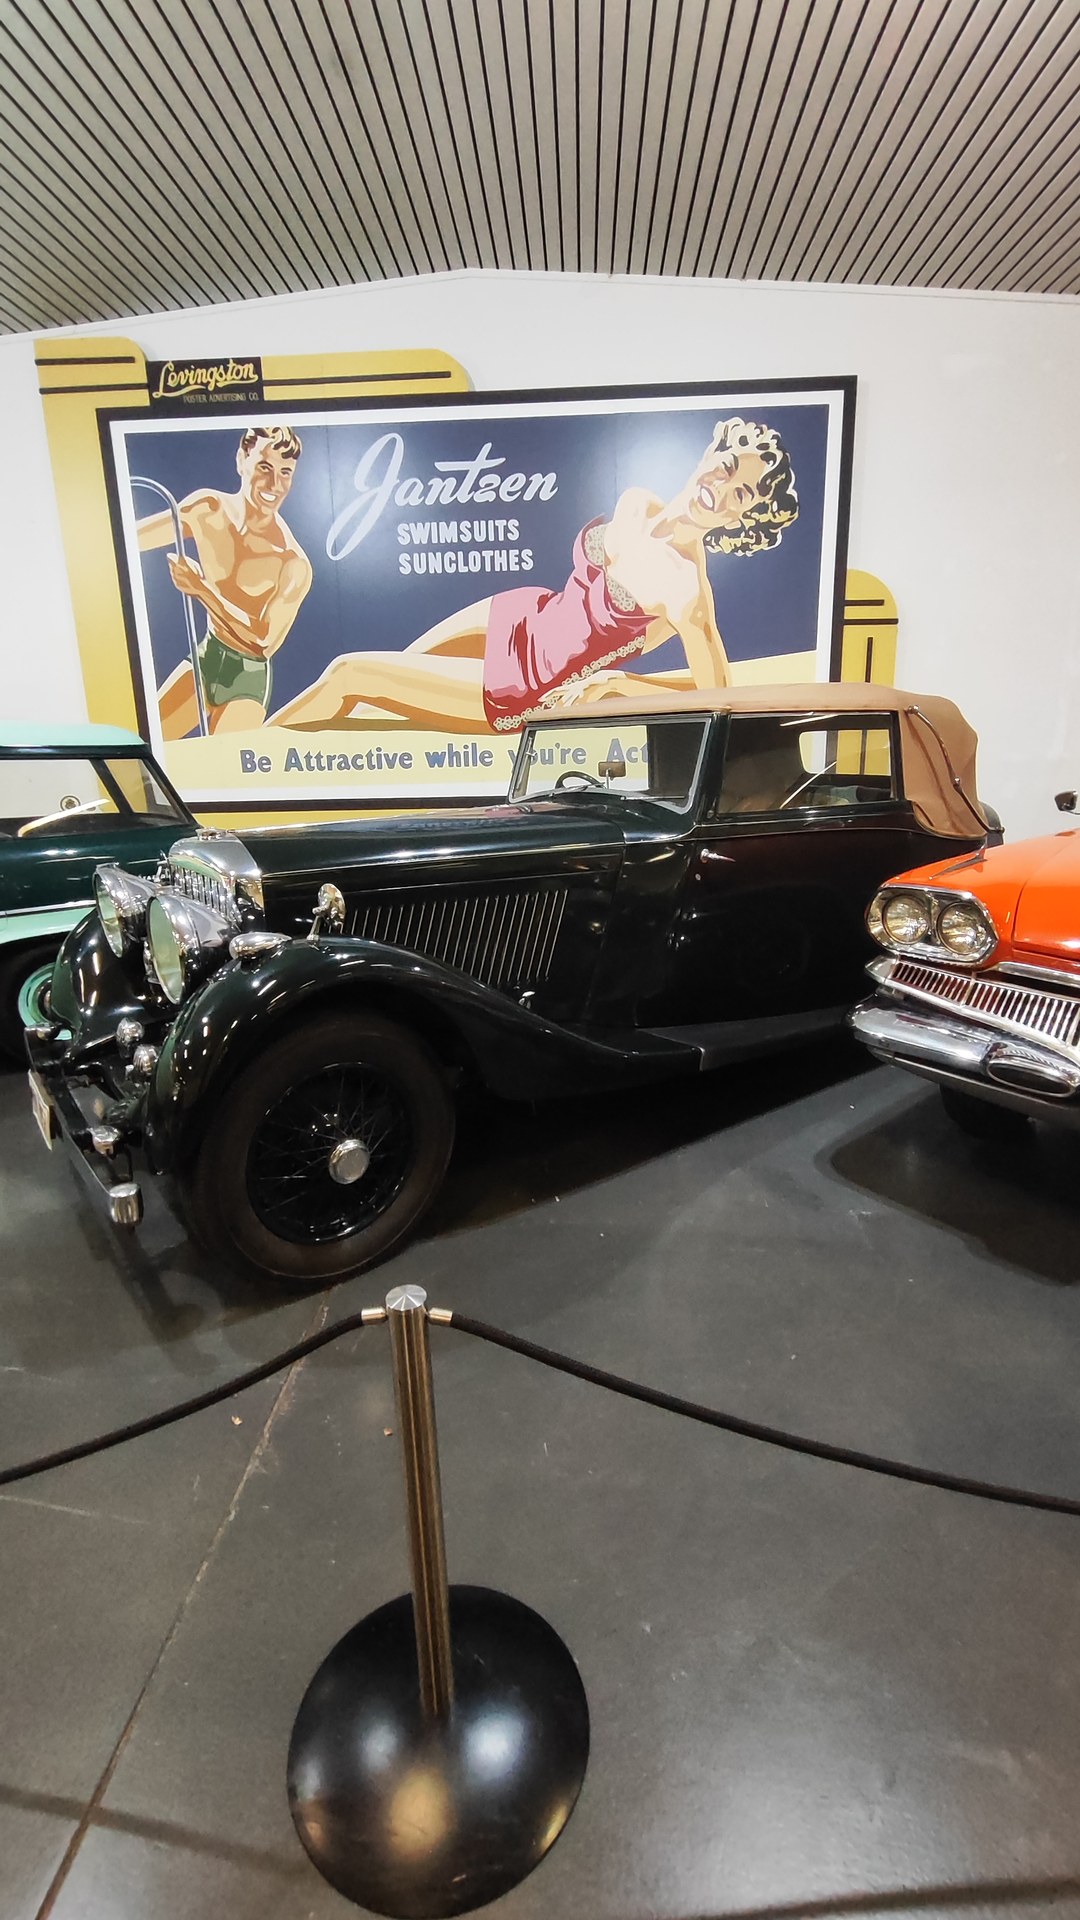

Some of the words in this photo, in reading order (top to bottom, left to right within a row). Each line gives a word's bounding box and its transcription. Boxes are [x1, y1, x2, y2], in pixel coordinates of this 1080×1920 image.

[152, 358, 258, 398] Levingston
[183, 394, 207, 404] POSTER
[326, 432, 559, 561] Jantzen
[397, 519, 520, 545] SWIMSUITS
[399, 549, 534, 575] SUNCLOTHES
[239, 749, 272, 773] Be
[284, 746, 413, 772] Attractive
[424, 742, 494, 769] while
